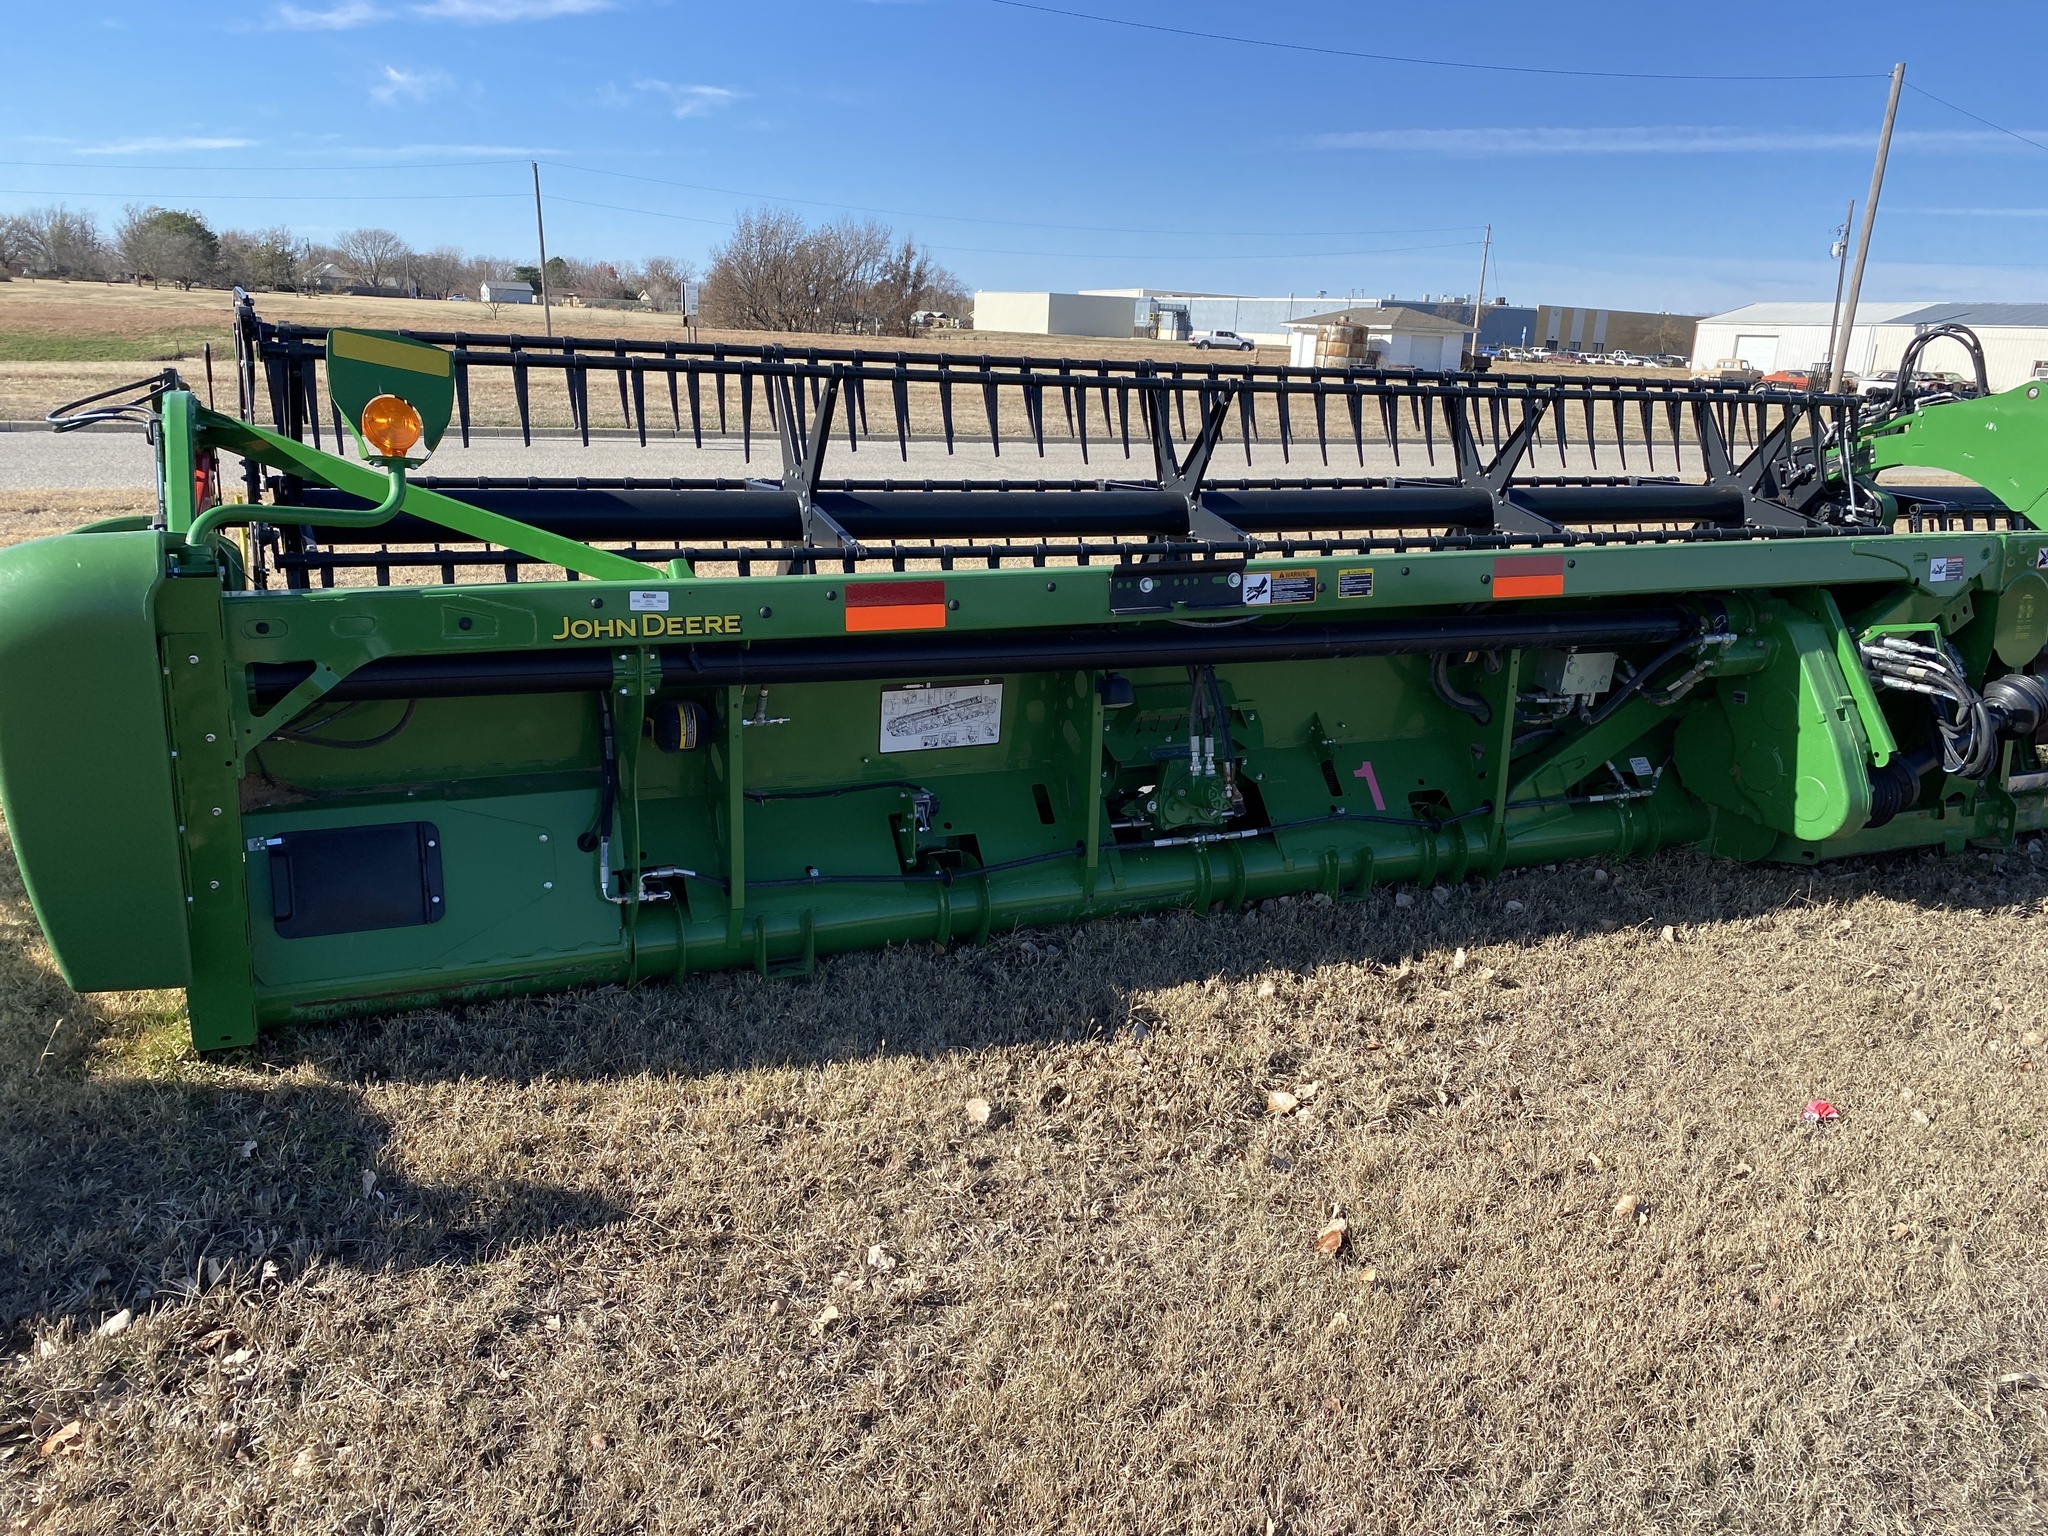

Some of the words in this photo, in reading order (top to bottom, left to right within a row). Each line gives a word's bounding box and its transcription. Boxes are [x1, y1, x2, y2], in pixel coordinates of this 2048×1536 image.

[1285, 570, 1310, 578] WARNING
[552, 616, 637, 641] JOHN
[642, 613, 742, 637] DEERE
[1353, 761, 1386, 811] 1
